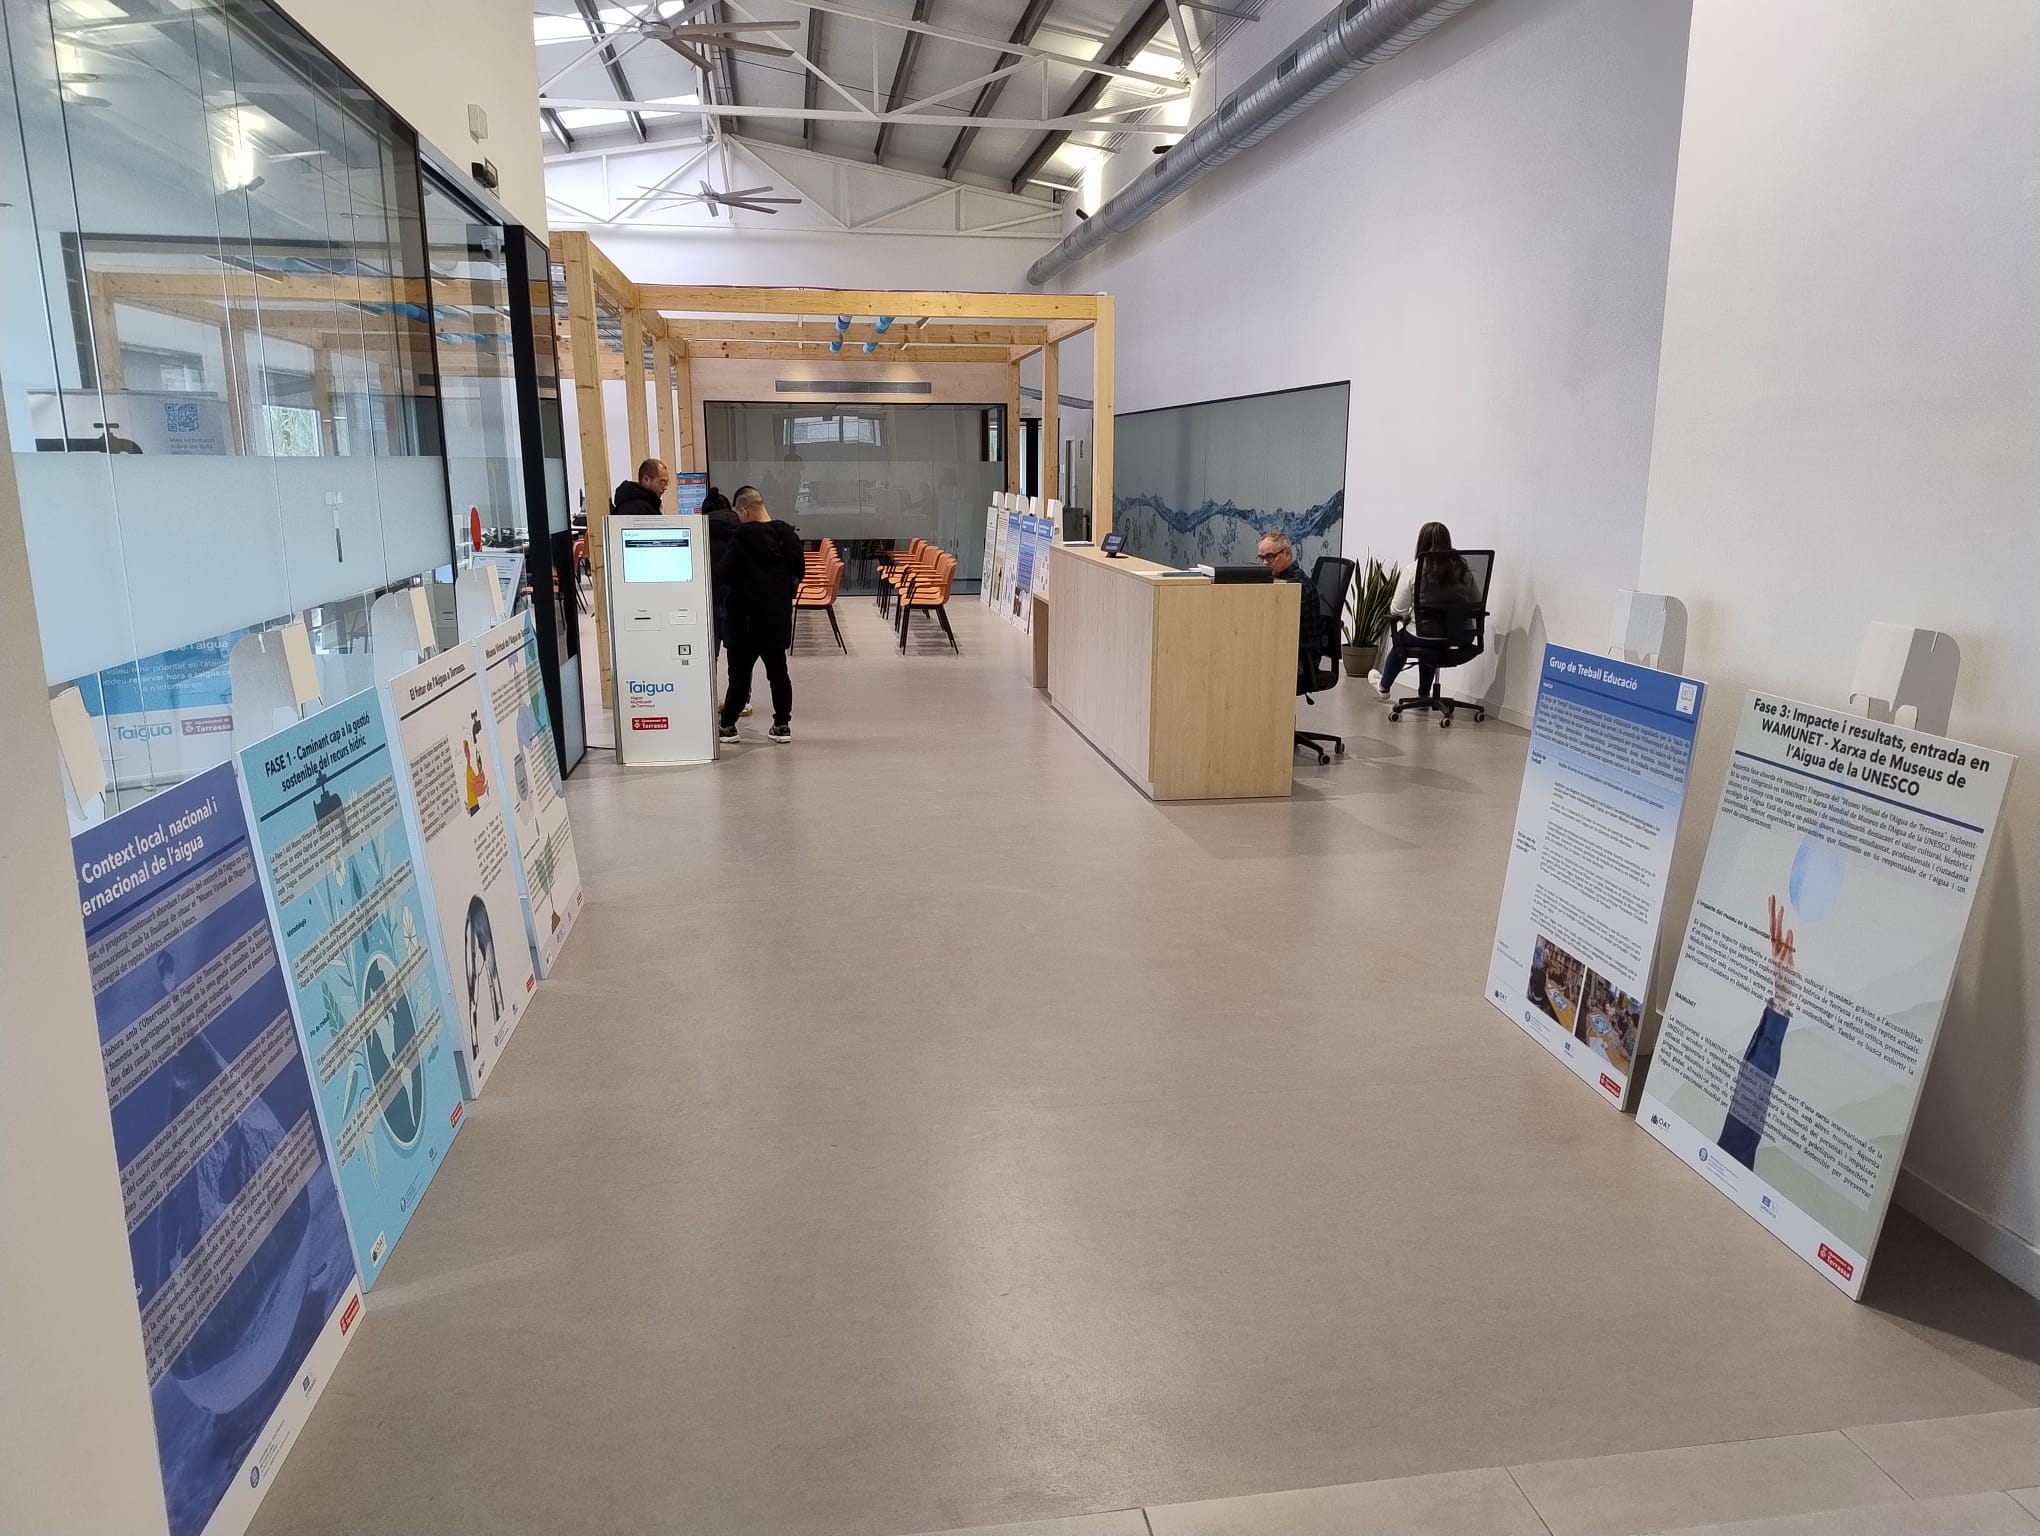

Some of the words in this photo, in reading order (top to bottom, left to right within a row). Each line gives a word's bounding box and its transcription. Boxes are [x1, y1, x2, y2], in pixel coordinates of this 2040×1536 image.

[409, 687, 415, 701] El
[414, 684, 427, 698] futur
[425, 679, 433, 692] de
[431, 672, 447, 688] l'Aigua
[626, 680, 674, 696] Taigua
[1548, 655, 1567, 673] Grup
[1566, 660, 1577, 673] de
[1576, 663, 1602, 681] Treball
[1602, 670, 1638, 691] Educació
[113, 722, 173, 742] Taigua
[196, 723, 231, 733] Terrassa
[264, 753, 286, 778] FASE
[295, 731, 329, 761] Caminant
[328, 728, 341, 744] cap
[344, 720, 352, 734] la
[351, 709, 370, 734] gestió
[1753, 697, 1777, 715] Fase
[1778, 704, 1790, 719] 3:
[1792, 707, 1840, 732] Impacte
[1840, 720, 1847, 734] i
[1847, 725, 1906, 752] resultats,
[1908, 741, 1967, 766] entrada
[1968, 757, 1990, 773] en
[281, 761, 319, 793] sostenible
[317, 752, 330, 771] del
[329, 745, 349, 764] recurs
[347, 733, 366, 753] hídric
[1760, 717, 1824, 747] WAMUNET
[1829, 737, 1868, 760] Xarxa
[1868, 747, 1888, 766] de
[1888, 753, 1944, 782] Museus
[1945, 769, 1967, 789] de
[1785, 743, 1827, 768] l'Aigua
[1827, 756, 1844, 774] de
[1845, 761, 1858, 778] la
[1859, 765, 1921, 798] UNESCO
[1860, 804, 1880, 816] Virtual
[1888, 813, 1908, 826] l'Aigua
[80, 838, 135, 886] Context
[134, 823, 169, 856] local,
[168, 798, 213, 838] nacional
[211, 795, 218, 814] i
[1835, 828, 1858, 841] incloent
[1891, 850, 1930, 869] professionals
[1934, 866, 1969, 883] ciutadania
[1857, 814, 1878, 827] Museus
[1887, 824, 1906, 837] l'Aigua
[1907, 831, 1915, 840] de
[1916, 834, 1922, 842] la
[1951, 846, 1976, 861] Aquest
[1866, 828, 1894, 843] destacant
[1901, 842, 1916, 851] valor
[1916, 848, 1941, 862] cultural,
[1943, 856, 1968, 870] històric
[149, 853, 168, 878] de
[166, 834, 204, 867] l'aigua
[1881, 858, 1916, 875] responsable
[1917, 870, 1926, 878] de
[1928, 874, 1949, 888] l'aigua
[105, 930, 128, 953] projecte
[97, 965, 120, 989] integral
[1828, 1000, 1851, 1017] Terrassa
[1877, 1028, 1896, 1042] reptes
[1881, 1016, 1923, 1044] l'accessibilitat
[108, 1047, 132, 1072] fomenta
[139, 1014, 169, 1049] participació
[109, 1073, 120, 1088] des
[120, 1062, 133, 1079] dels
[133, 1048, 150, 1068] canals
[151, 1031, 170, 1053] romans
[1883, 1043, 1918, 1066] promovent
[135, 1147, 153, 1171] museu
[1807, 1140, 1836, 1163] pràctiques
[1836, 1160, 1868, 1185] sostenibles
[1818, 1136, 1843, 1156] personal
[1856, 1148, 1879, 1169] Aquesta
[135, 1165, 150, 1188] canvi
[1802, 1146, 1830, 1170] Sostenible
[1831, 1168, 1841, 1179] per
[1842, 1176, 1871, 1200] preservar
[1825, 1253, 1850, 1279] Terrassa
